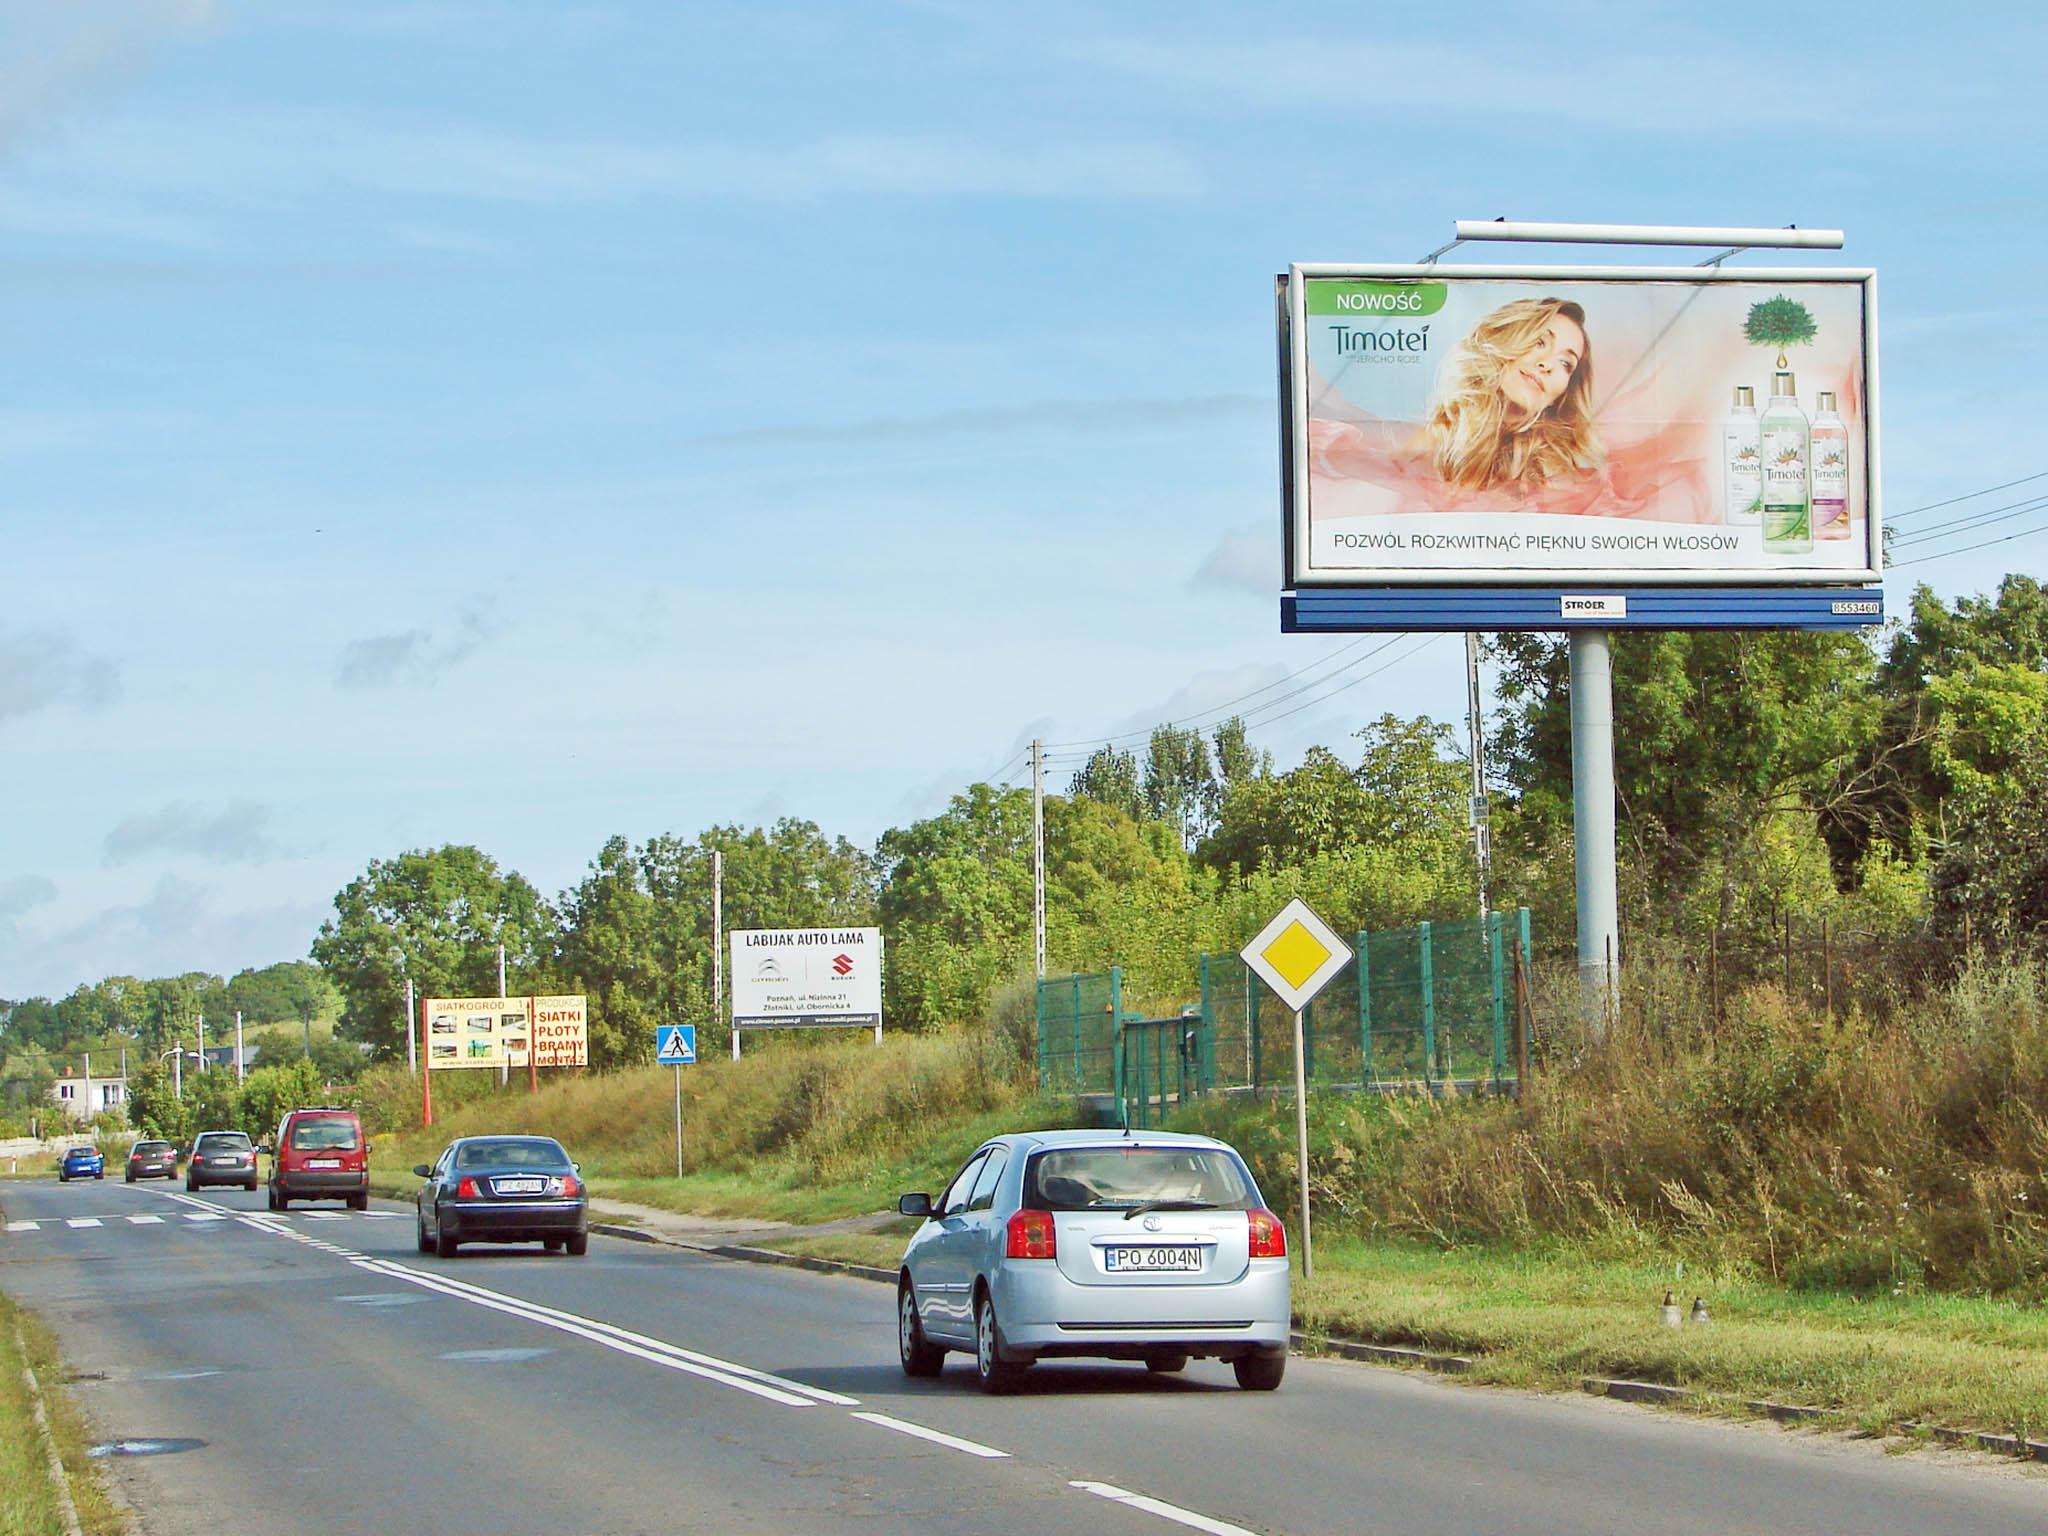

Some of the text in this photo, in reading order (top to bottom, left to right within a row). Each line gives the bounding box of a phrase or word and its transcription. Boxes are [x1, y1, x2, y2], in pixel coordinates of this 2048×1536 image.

[1336, 292, 1422, 311] NOWOŚĆ
[1328, 324, 1431, 355] Timotei
[1765, 467, 1806, 481] Timotei
[1814, 467, 1846, 480] Timotei
[1334, 531, 1739, 552] POZWÓL ROZKWITNĄĆ PIĘKNU SWOICH WŁOSÓW
[1834, 603, 1878, 612] 8553460
[746, 932, 864, 946] LABIJAK AUTO LAMA
[539, 1011, 581, 1022] SIATKI
[539, 1040, 584, 1051] BRAMY
[1118, 1249, 1198, 1265] PO 6004N
